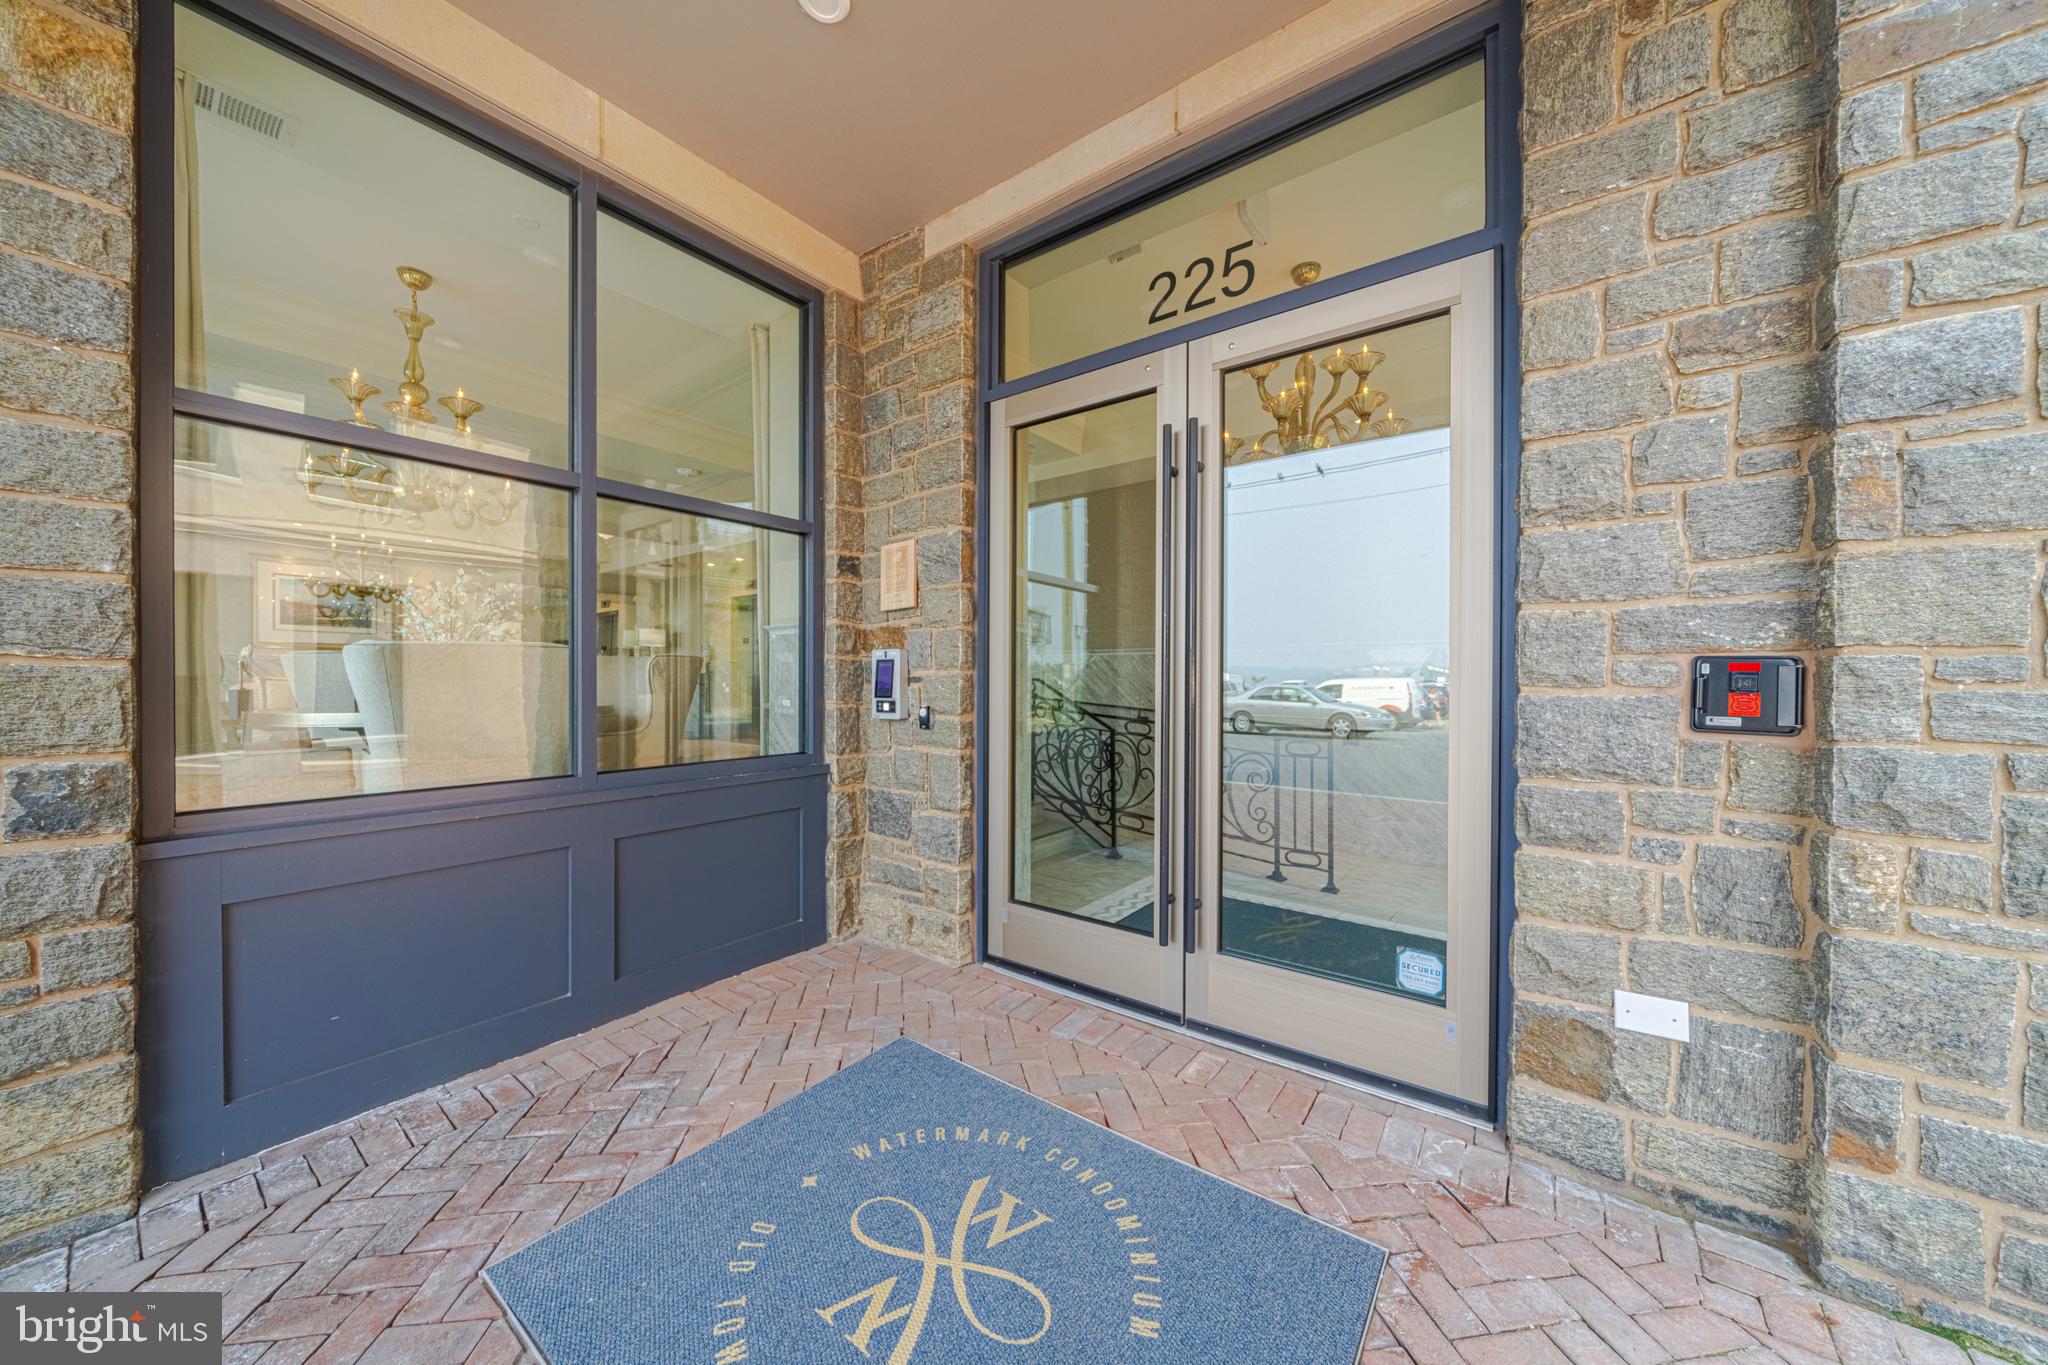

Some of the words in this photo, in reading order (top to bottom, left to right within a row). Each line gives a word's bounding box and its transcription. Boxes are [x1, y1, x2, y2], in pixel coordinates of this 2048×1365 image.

[1147, 239, 1256, 325] 225
[1401, 961, 1442, 978] SECURED
[728, 1221, 777, 1274] OLD
[851, 1126, 1032, 1161] WATERMARK
[1044, 1147, 1163, 1339] CONDOMINIUM
